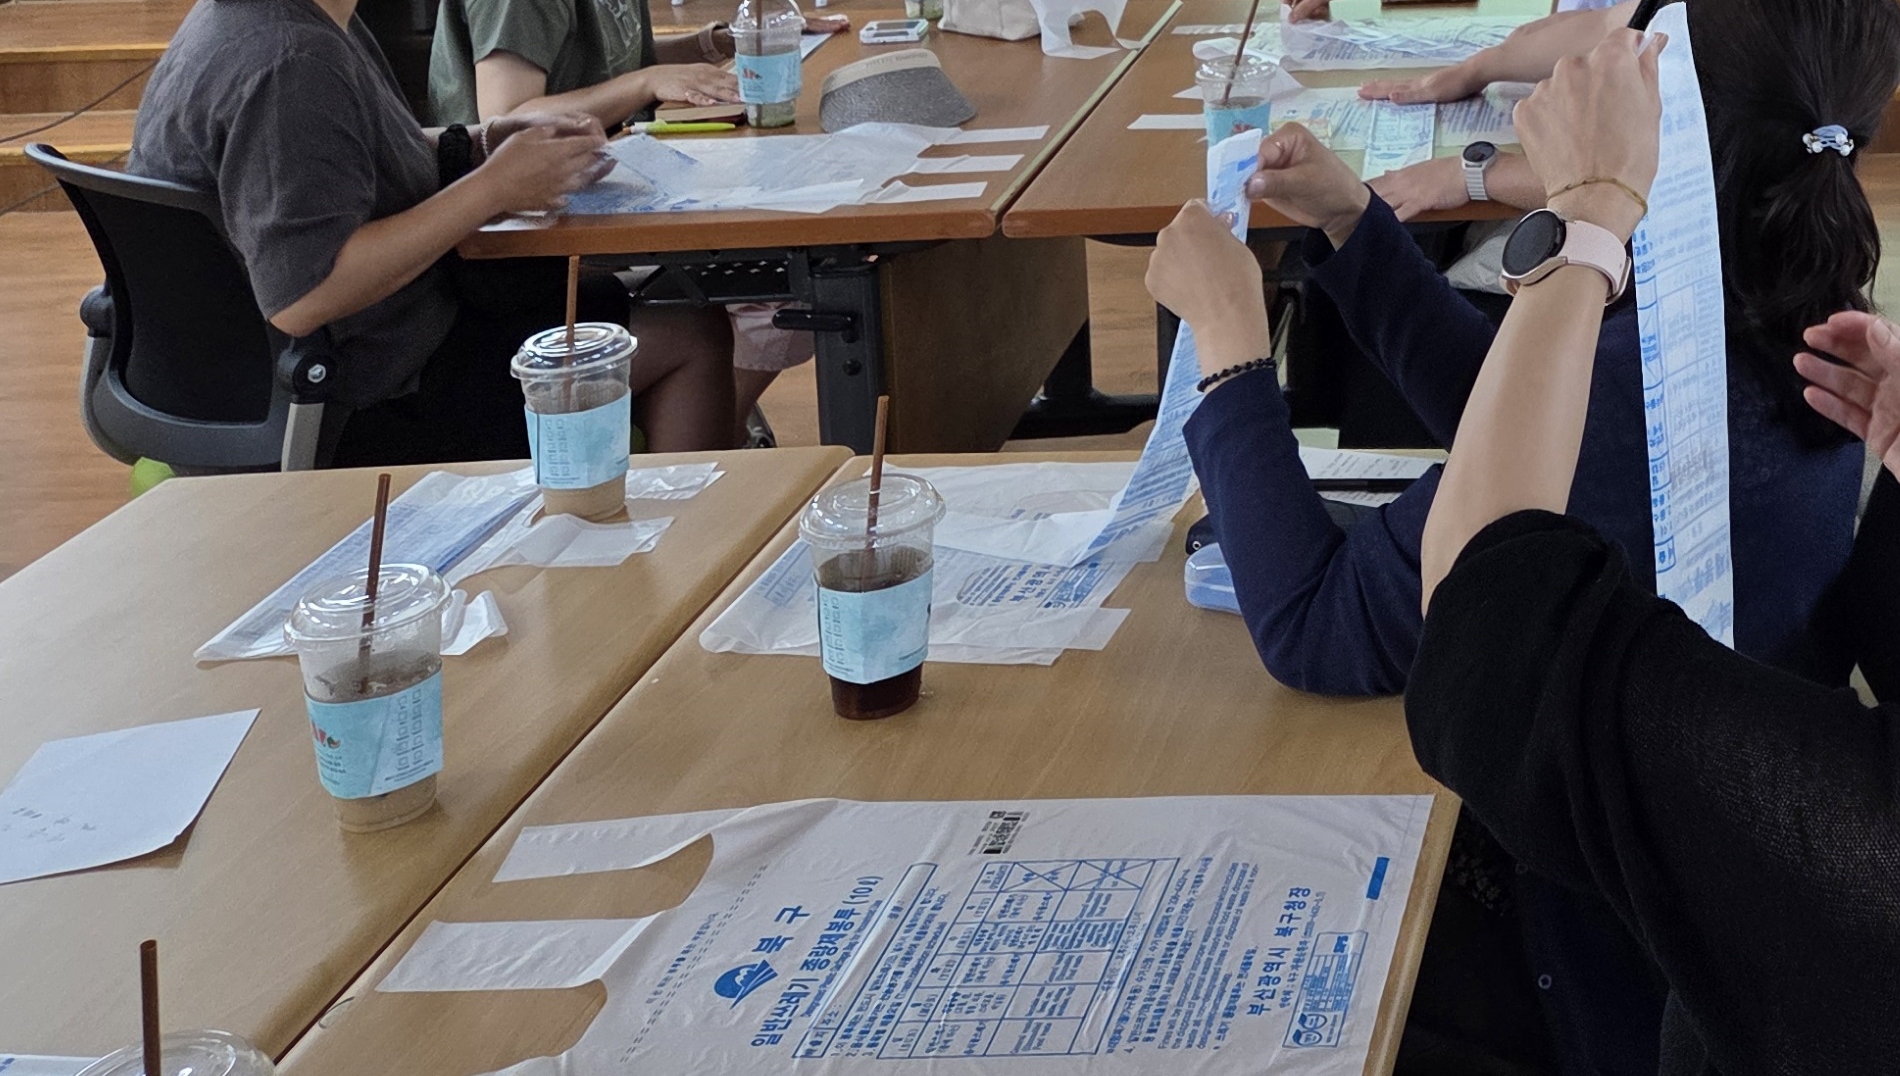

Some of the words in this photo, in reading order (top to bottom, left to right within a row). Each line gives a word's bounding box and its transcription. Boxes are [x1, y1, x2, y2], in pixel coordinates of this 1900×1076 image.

[747, 978, 819, 1046] 일반쓰레기
[797, 907, 855, 971] 종량제봉투
[1245, 947, 1292, 1015] 부산광역시
[1272, 886, 1312, 937] 북구청장
